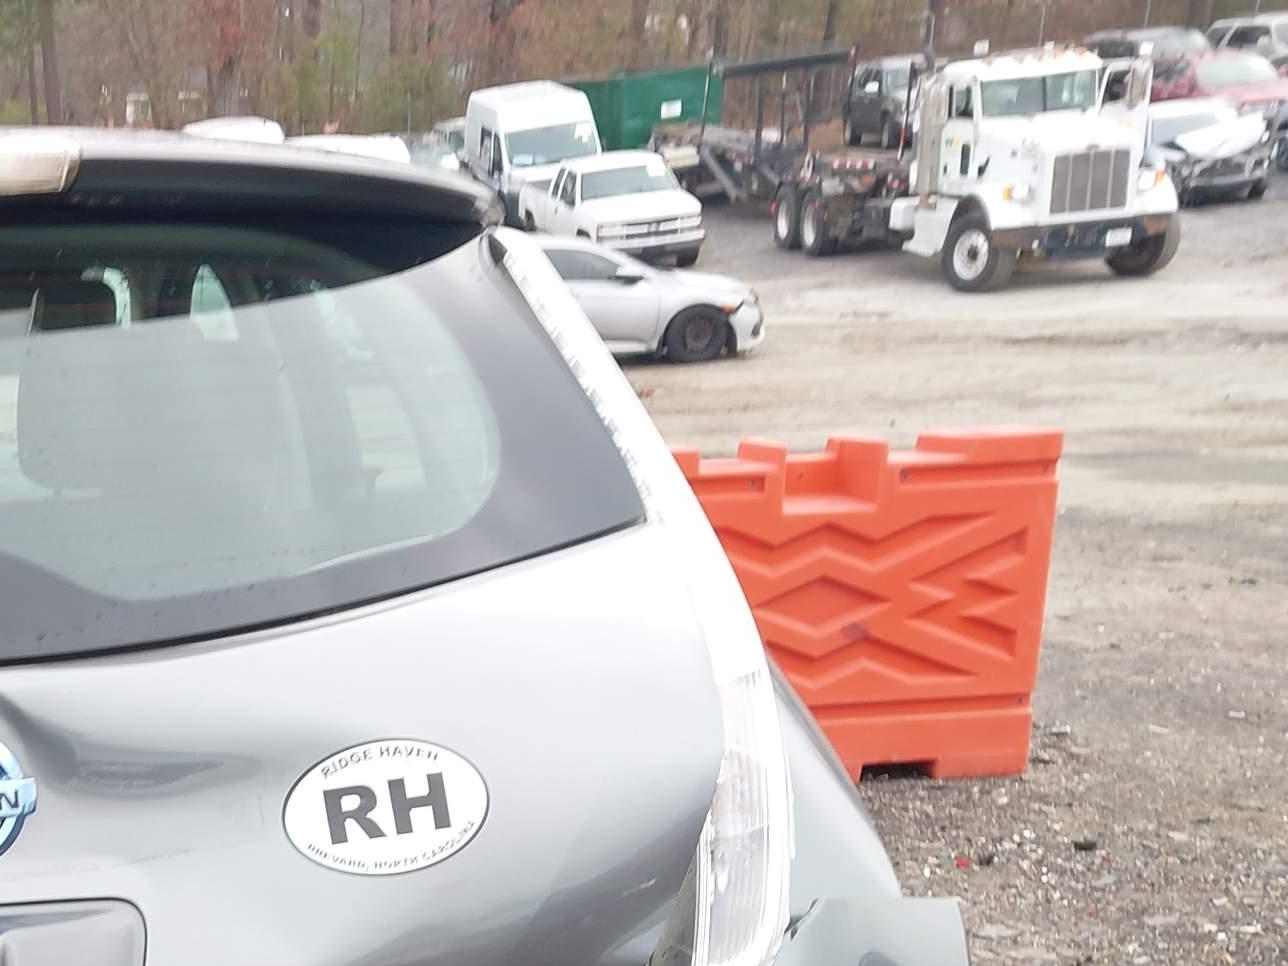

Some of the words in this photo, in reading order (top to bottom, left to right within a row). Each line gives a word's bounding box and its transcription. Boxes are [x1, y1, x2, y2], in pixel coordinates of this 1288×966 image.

[321, 748, 372, 778] RIDGE
[379, 745, 439, 761] HAVEN
[323, 771, 452, 845] RH
